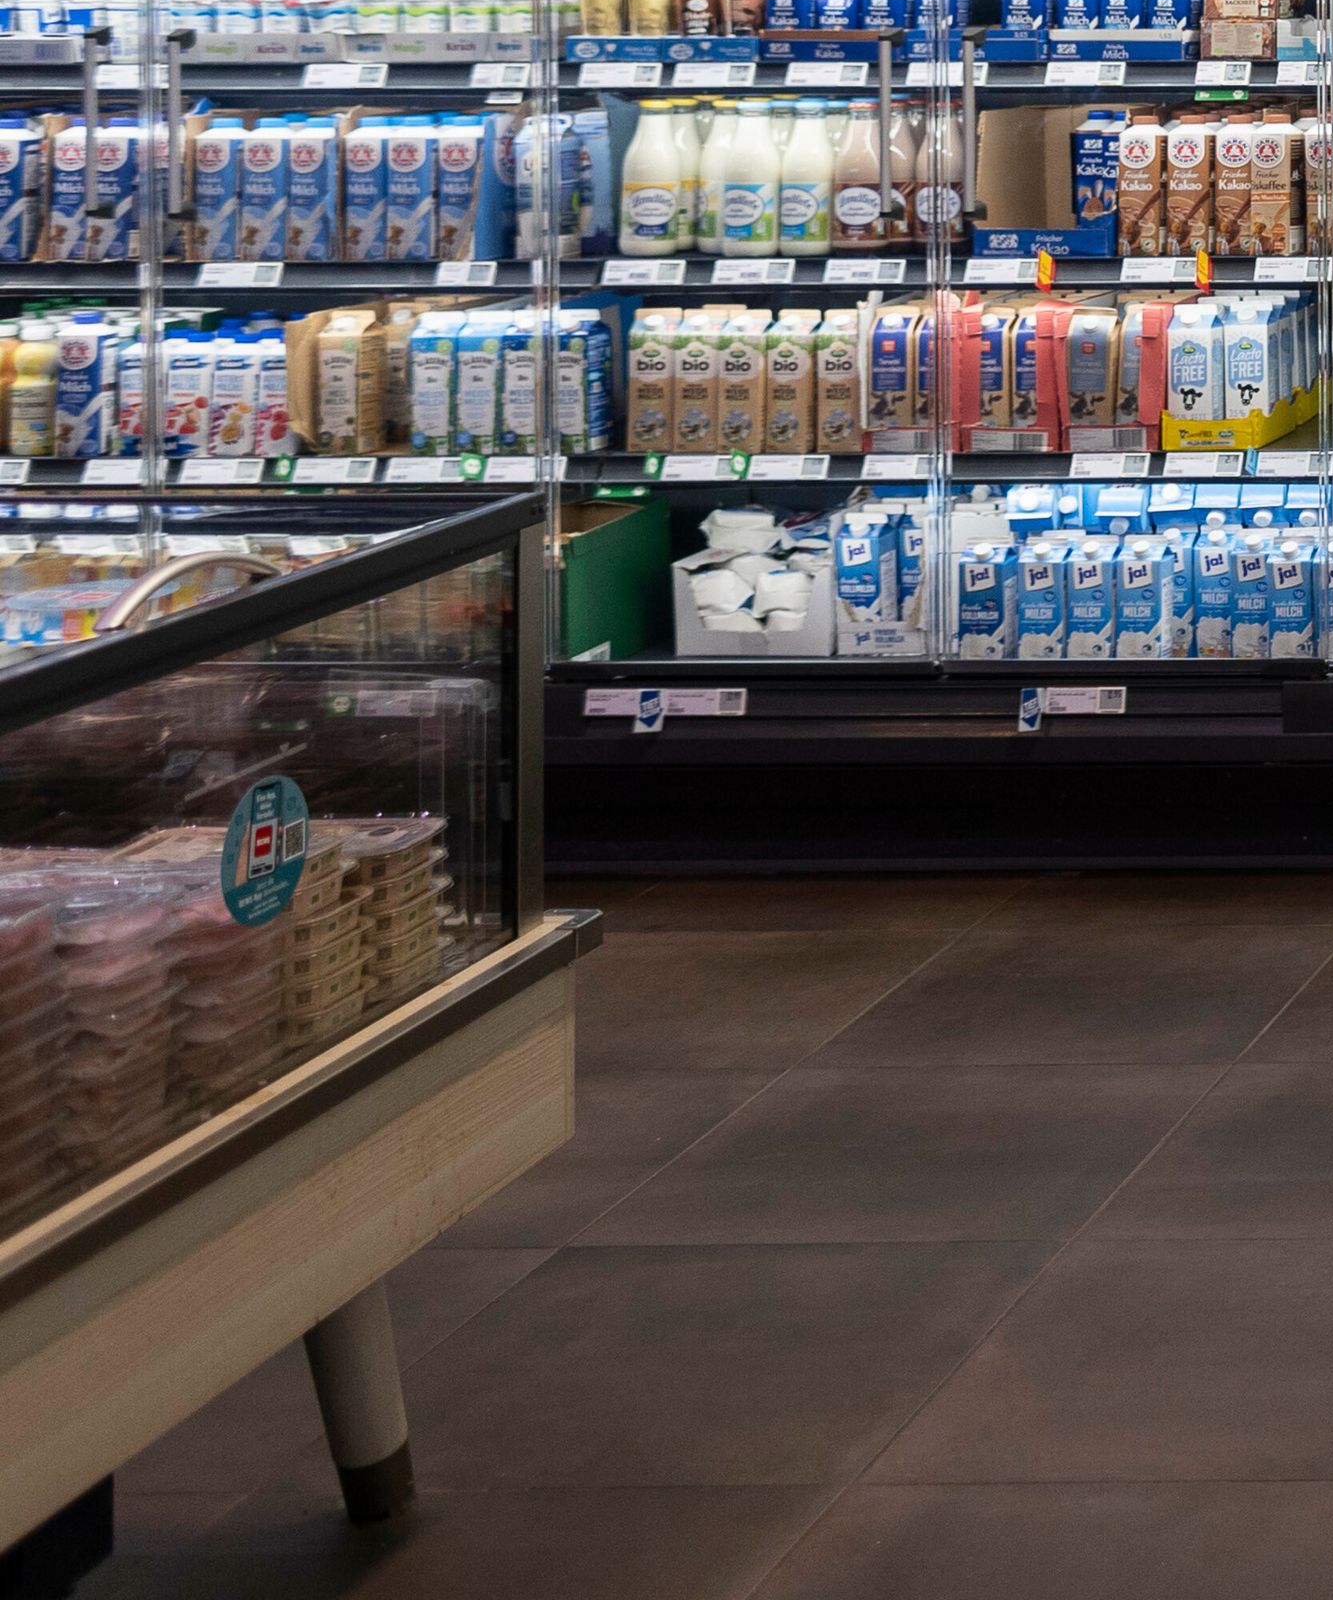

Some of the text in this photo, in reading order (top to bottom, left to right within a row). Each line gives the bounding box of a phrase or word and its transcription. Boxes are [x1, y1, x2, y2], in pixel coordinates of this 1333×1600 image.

[1064, 16, 1090, 26] Milch
[1105, 16, 1130, 26] Milch
[1152, 16, 1178, 26] Milch
[1102, 50, 1129, 60] Milch
[1124, 169, 1150, 179] Frischer
[1173, 169, 1199, 179] Frischer
[1221, 169, 1248, 179] Frischer
[1121, 179, 1152, 191] Kakao
[1170, 179, 1202, 191] Kakao
[1218, 179, 1250, 190] Kakao
[1173, 352, 1206, 365] Lacto
[1231, 348, 1262, 361] Lacto
[637, 358, 665, 371] bio
[682, 358, 708, 371] bio
[725, 359, 751, 372] bio
[772, 359, 798, 372] bio
[825, 358, 852, 371] bio
[1231, 361, 1262, 379] FREE
[1174, 365, 1205, 384] FREE
[847, 543, 865, 557] ja!
[1205, 553, 1223, 572] ja!
[1241, 559, 1261, 578] ja!
[970, 567, 990, 581] ja!
[1028, 567, 1049, 585] ja!
[1077, 565, 1098, 584] ja!
[1127, 565, 1148, 584] ja!
[1278, 564, 1298, 584] ja!
[1201, 592, 1229, 603] MILCH
[1238, 598, 1266, 609] MILCH
[1024, 607, 1053, 618] MILCH
[1073, 606, 1101, 618] MILCH
[1123, 606, 1151, 618] MILCH
[1275, 606, 1303, 618] MILCH
[856, 632, 870, 646] ja!
